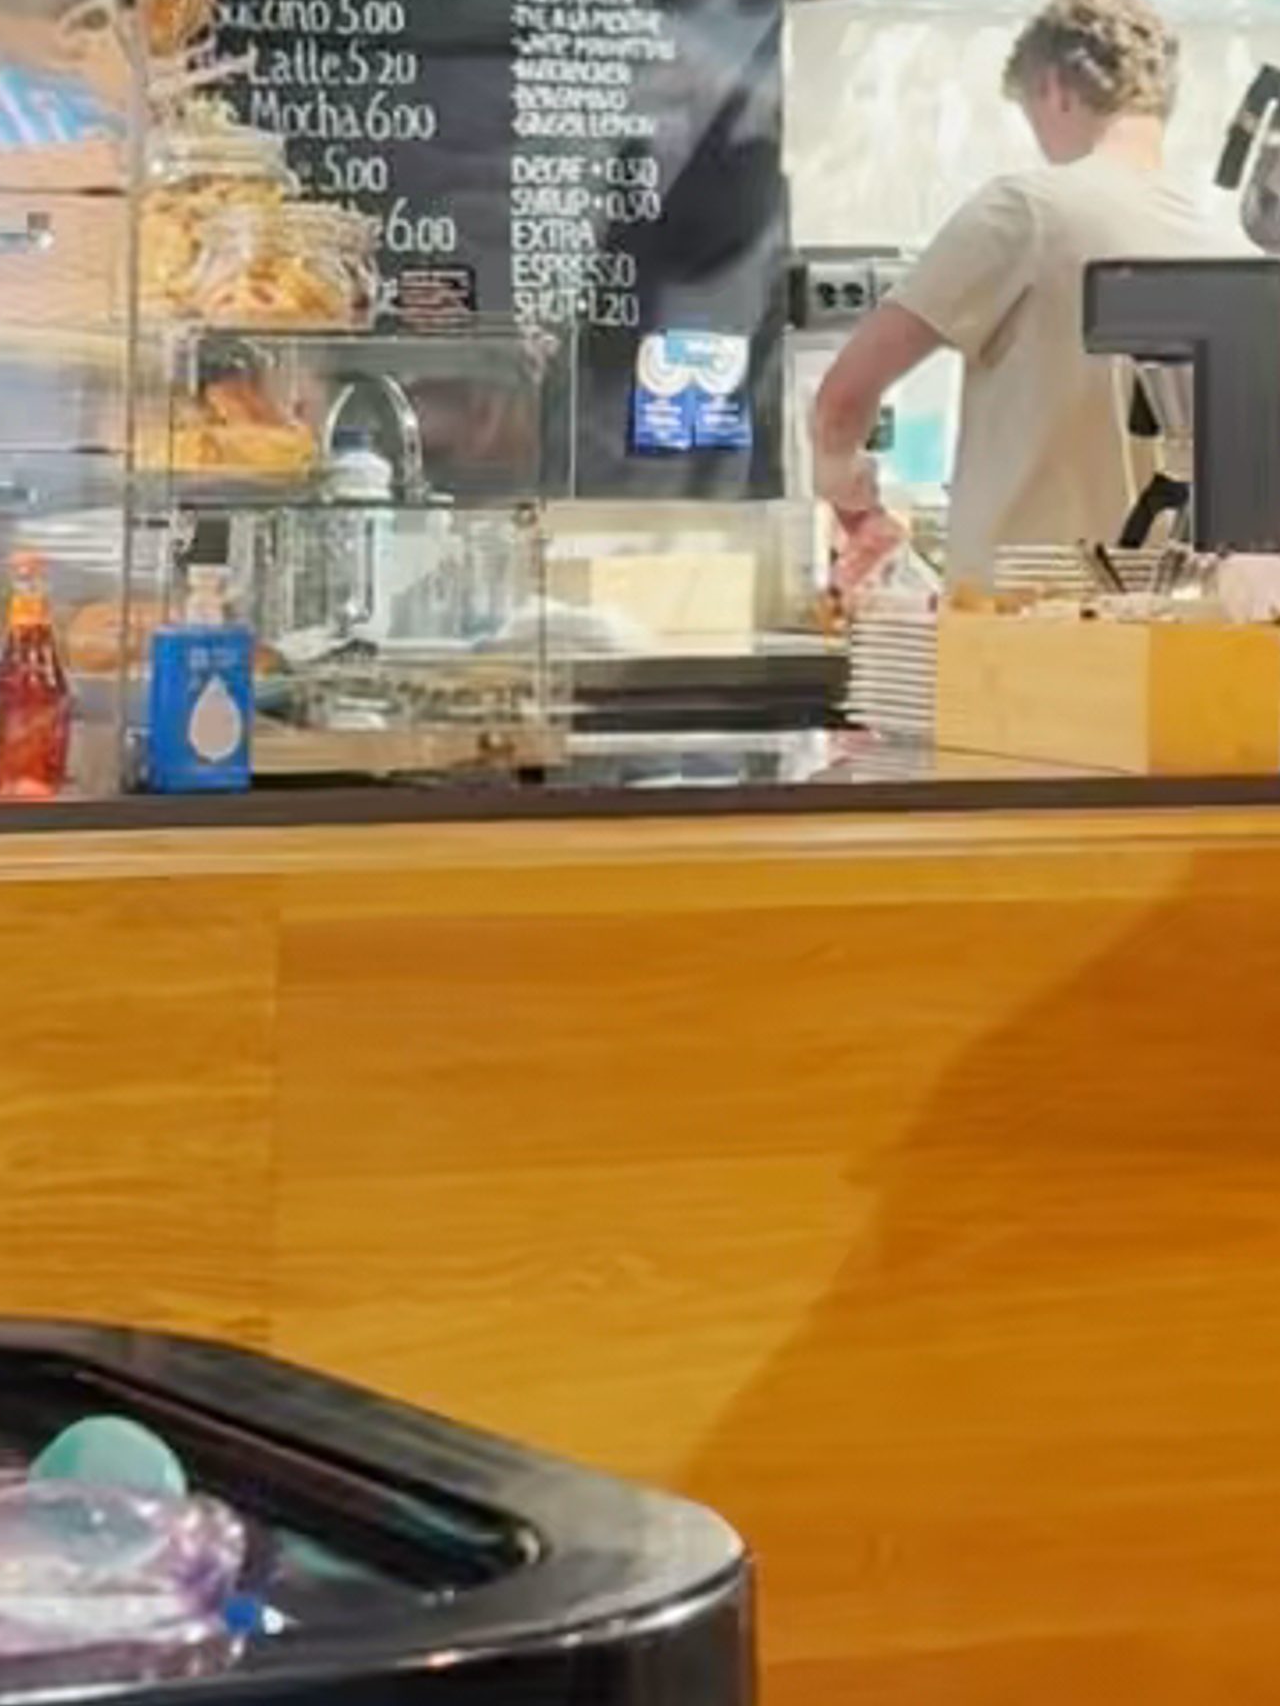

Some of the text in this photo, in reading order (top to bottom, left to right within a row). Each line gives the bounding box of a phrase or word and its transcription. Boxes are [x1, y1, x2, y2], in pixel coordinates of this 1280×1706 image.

[247, 37, 342, 85] Latte
[251, 88, 362, 139] Mocha
[510, 217, 597, 252] EXTRA
[510, 253, 637, 289] ESPRESSO
